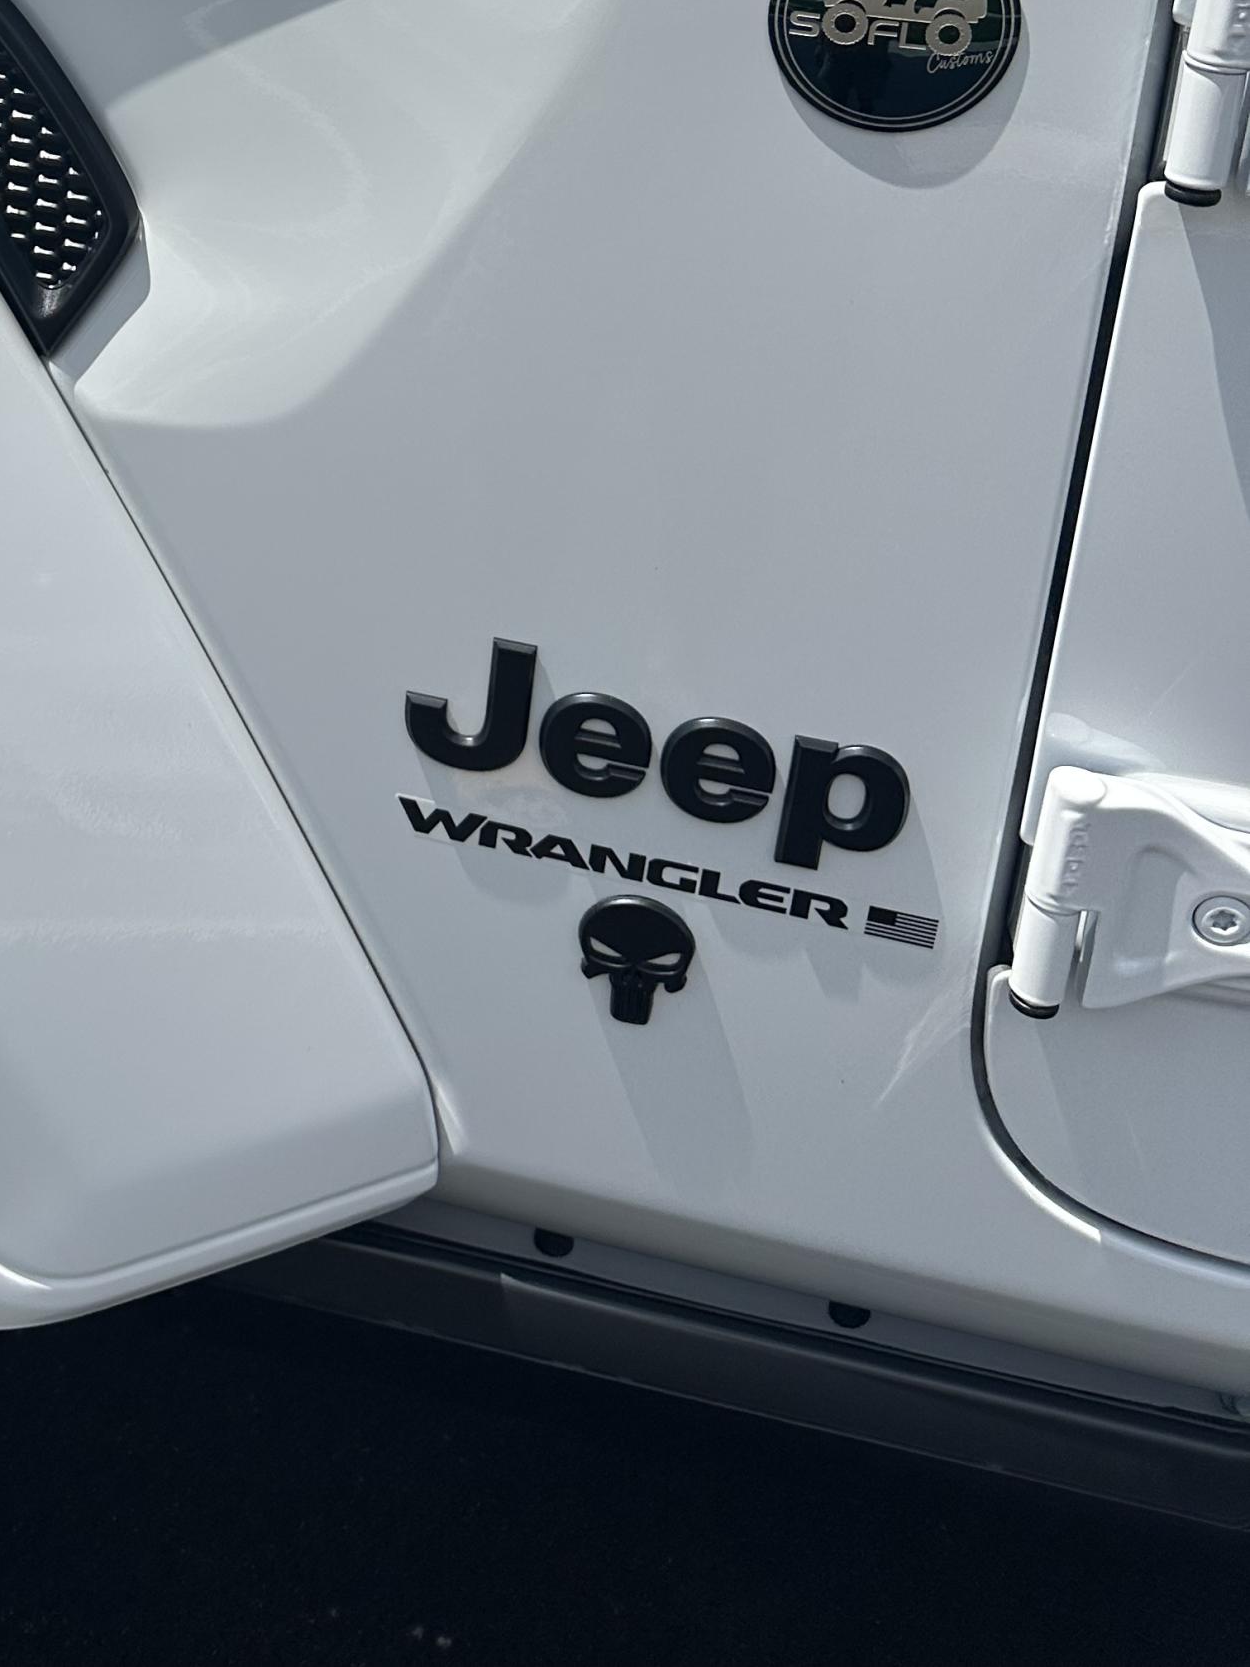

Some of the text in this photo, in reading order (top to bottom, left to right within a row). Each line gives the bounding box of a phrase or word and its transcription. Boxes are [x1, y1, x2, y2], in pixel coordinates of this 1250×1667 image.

[788, 0, 973, 56] SOFLO
[926, 50, 993, 73] Customs
[405, 637, 911, 870] Jeep
[398, 796, 849, 930] WRANGLER
